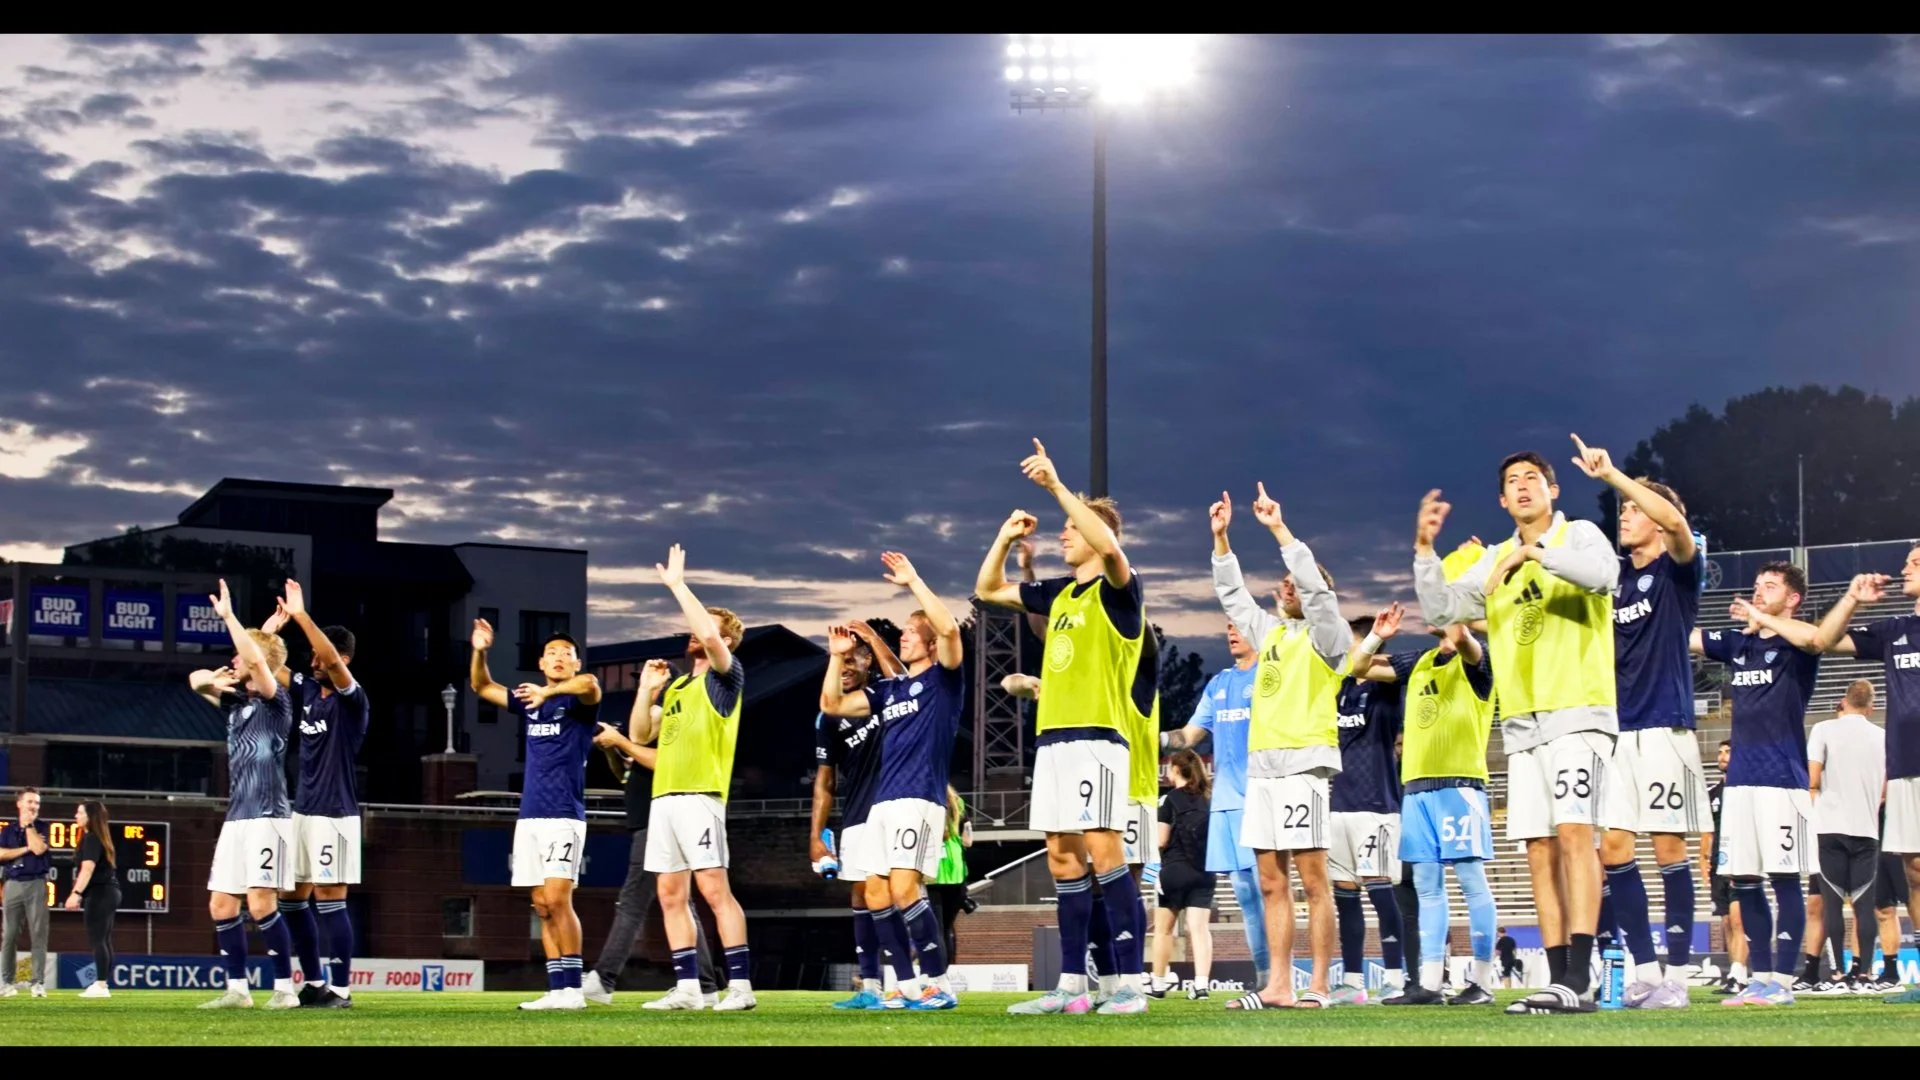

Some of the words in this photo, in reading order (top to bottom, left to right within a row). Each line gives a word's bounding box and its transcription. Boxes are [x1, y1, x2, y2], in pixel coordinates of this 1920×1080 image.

[41, 597, 76, 611] BUD
[115, 602, 150, 618] BUD
[35, 610, 82, 626] LIGHT
[108, 614, 155, 632] LIGHT
[1080, 780, 1093, 807] 9
[1555, 767, 1591, 800] 58
[1649, 782, 1683, 810] 26
[1283, 804, 1309, 829] 22
[698, 827, 712, 849] 4
[1779, 825, 1795, 851] 3
[145, 841, 160, 866] 3
[260, 847, 273, 870] 2
[319, 845, 333, 866] 5
[127, 868, 151, 882] QTR
[114, 965, 262, 988] CFCTIX.CM
[385, 972, 422, 986] FOOD
[445, 972, 473, 986] CITY
[1210, 979, 1245, 993] Optics
